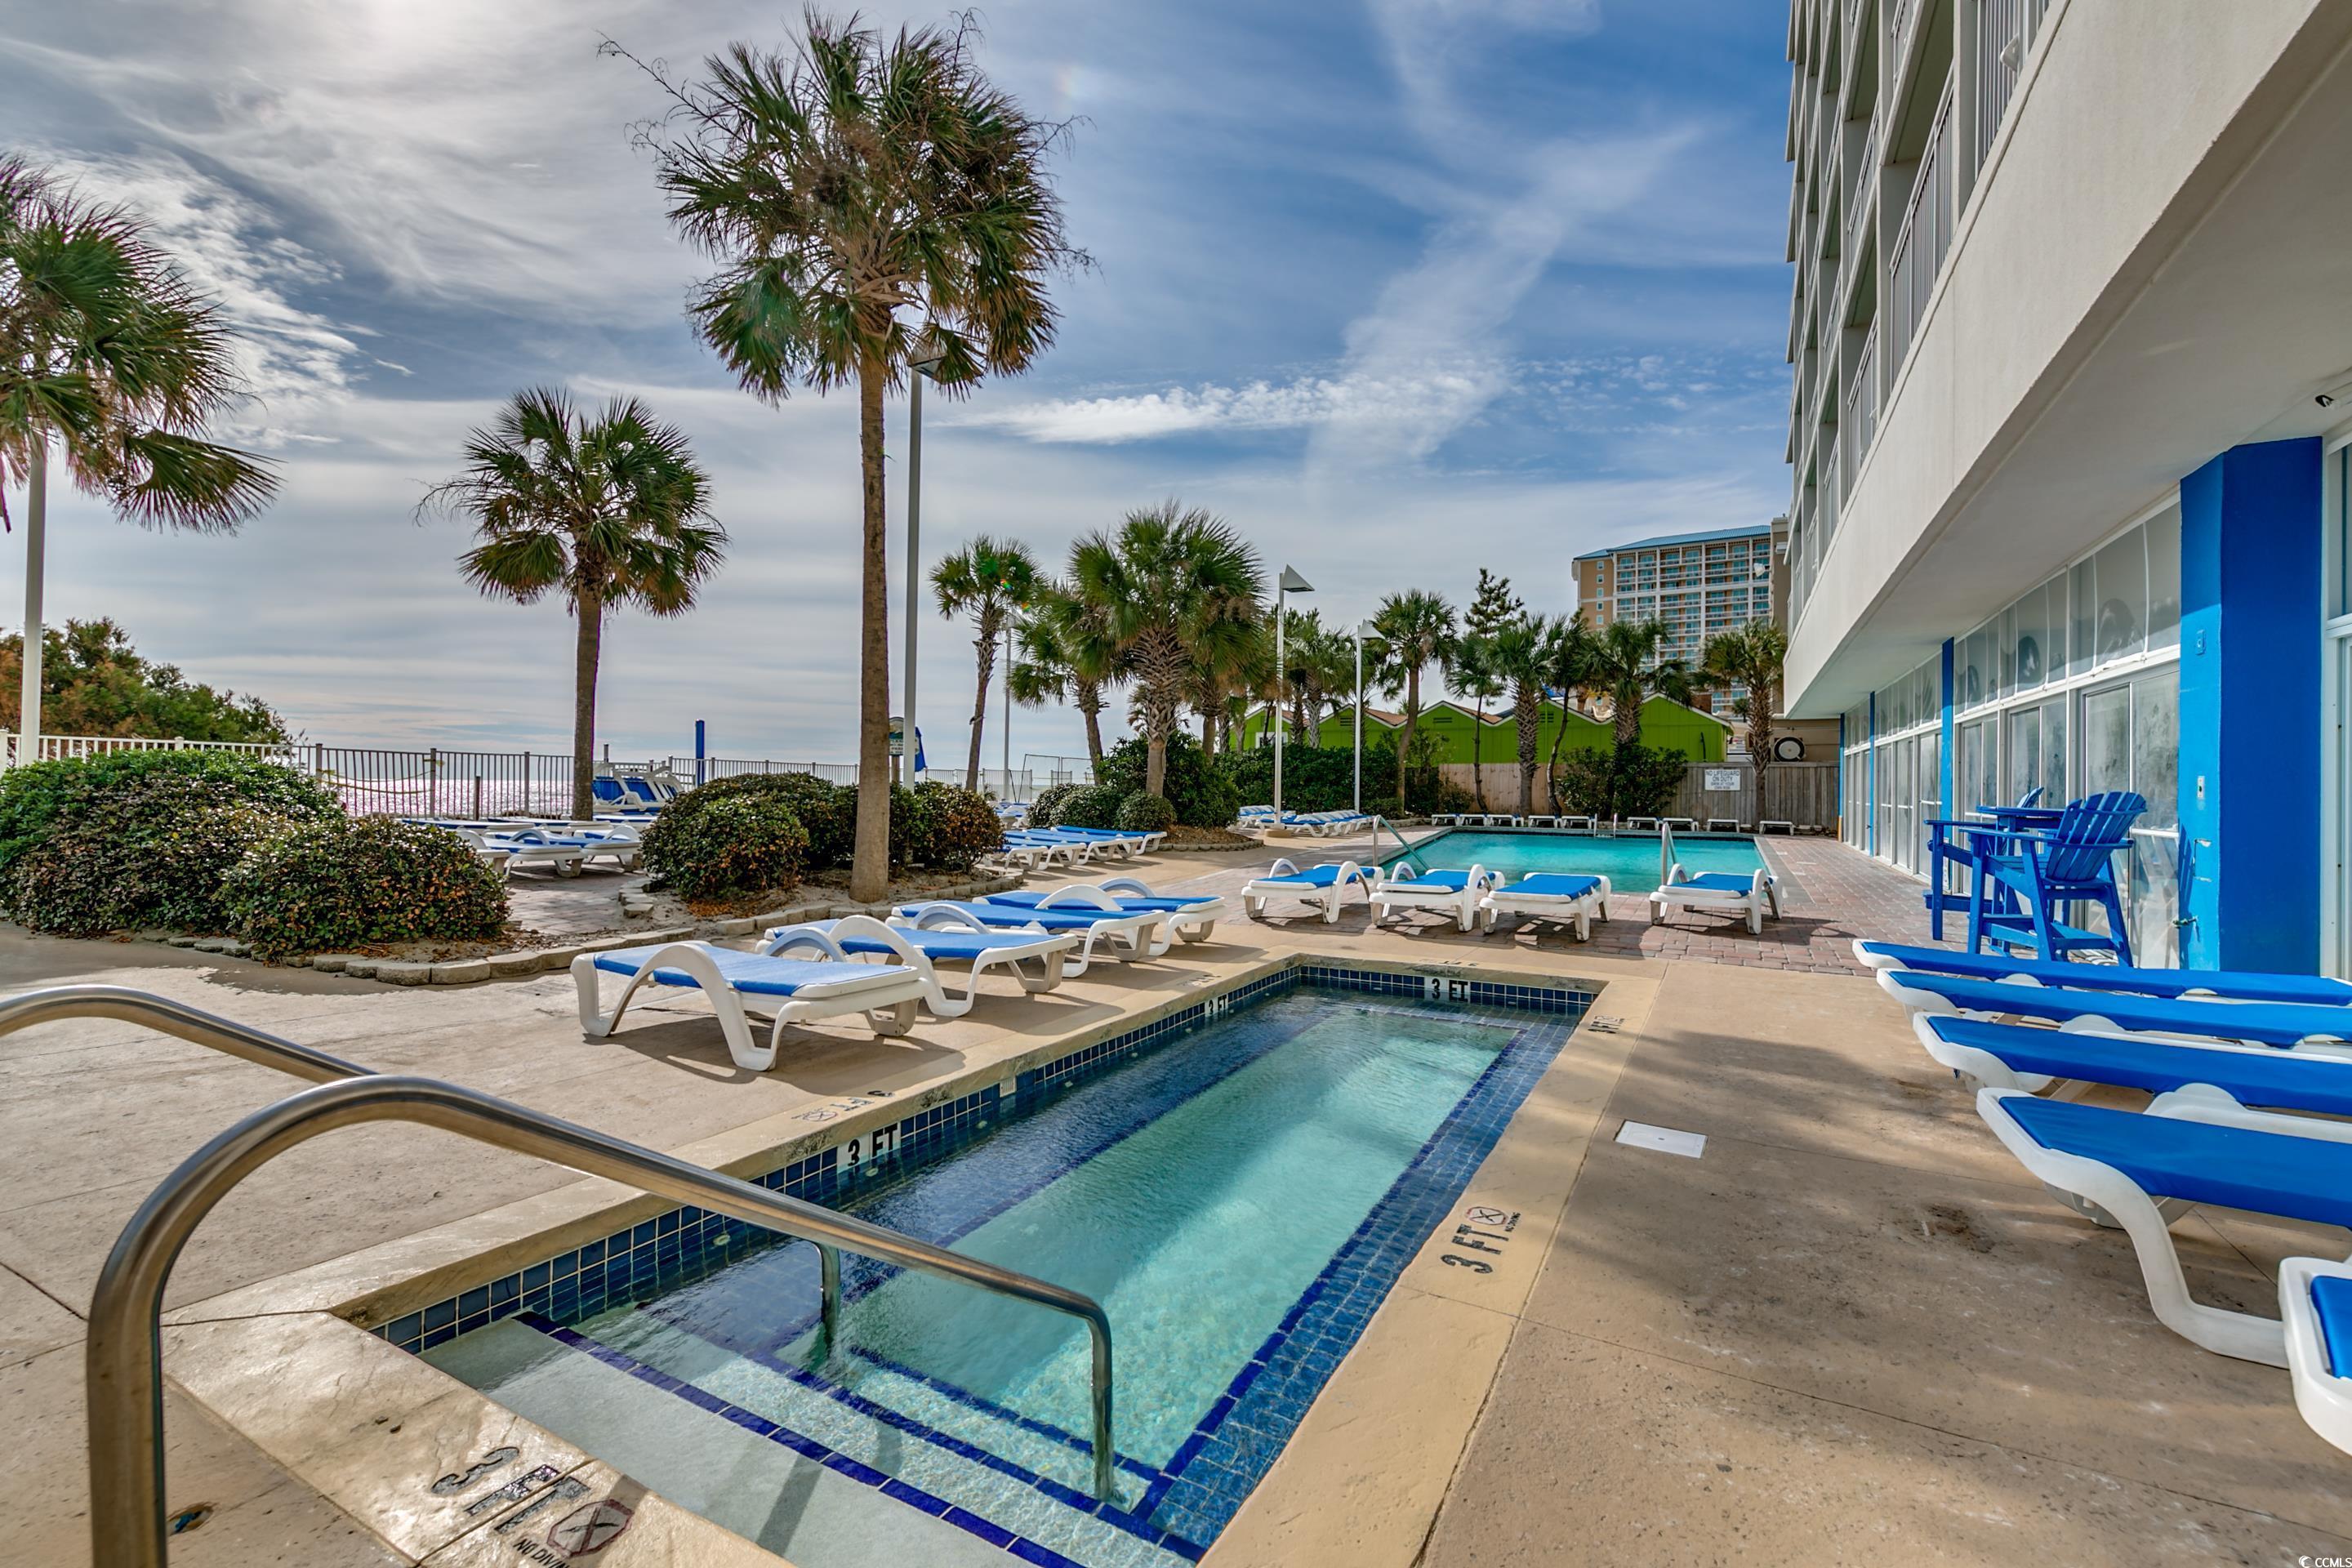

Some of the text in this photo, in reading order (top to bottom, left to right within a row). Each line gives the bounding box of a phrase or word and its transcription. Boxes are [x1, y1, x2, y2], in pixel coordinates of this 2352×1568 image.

[1432, 978, 1441, 995] 3
[1209, 994, 1227, 1014] 3 FT
[848, 1123, 898, 1167] 3 FT
[1441, 1223, 1509, 1274] 3 FT
[430, 1446, 591, 1535] 3 FT
[513, 1539, 539, 1555] NO
